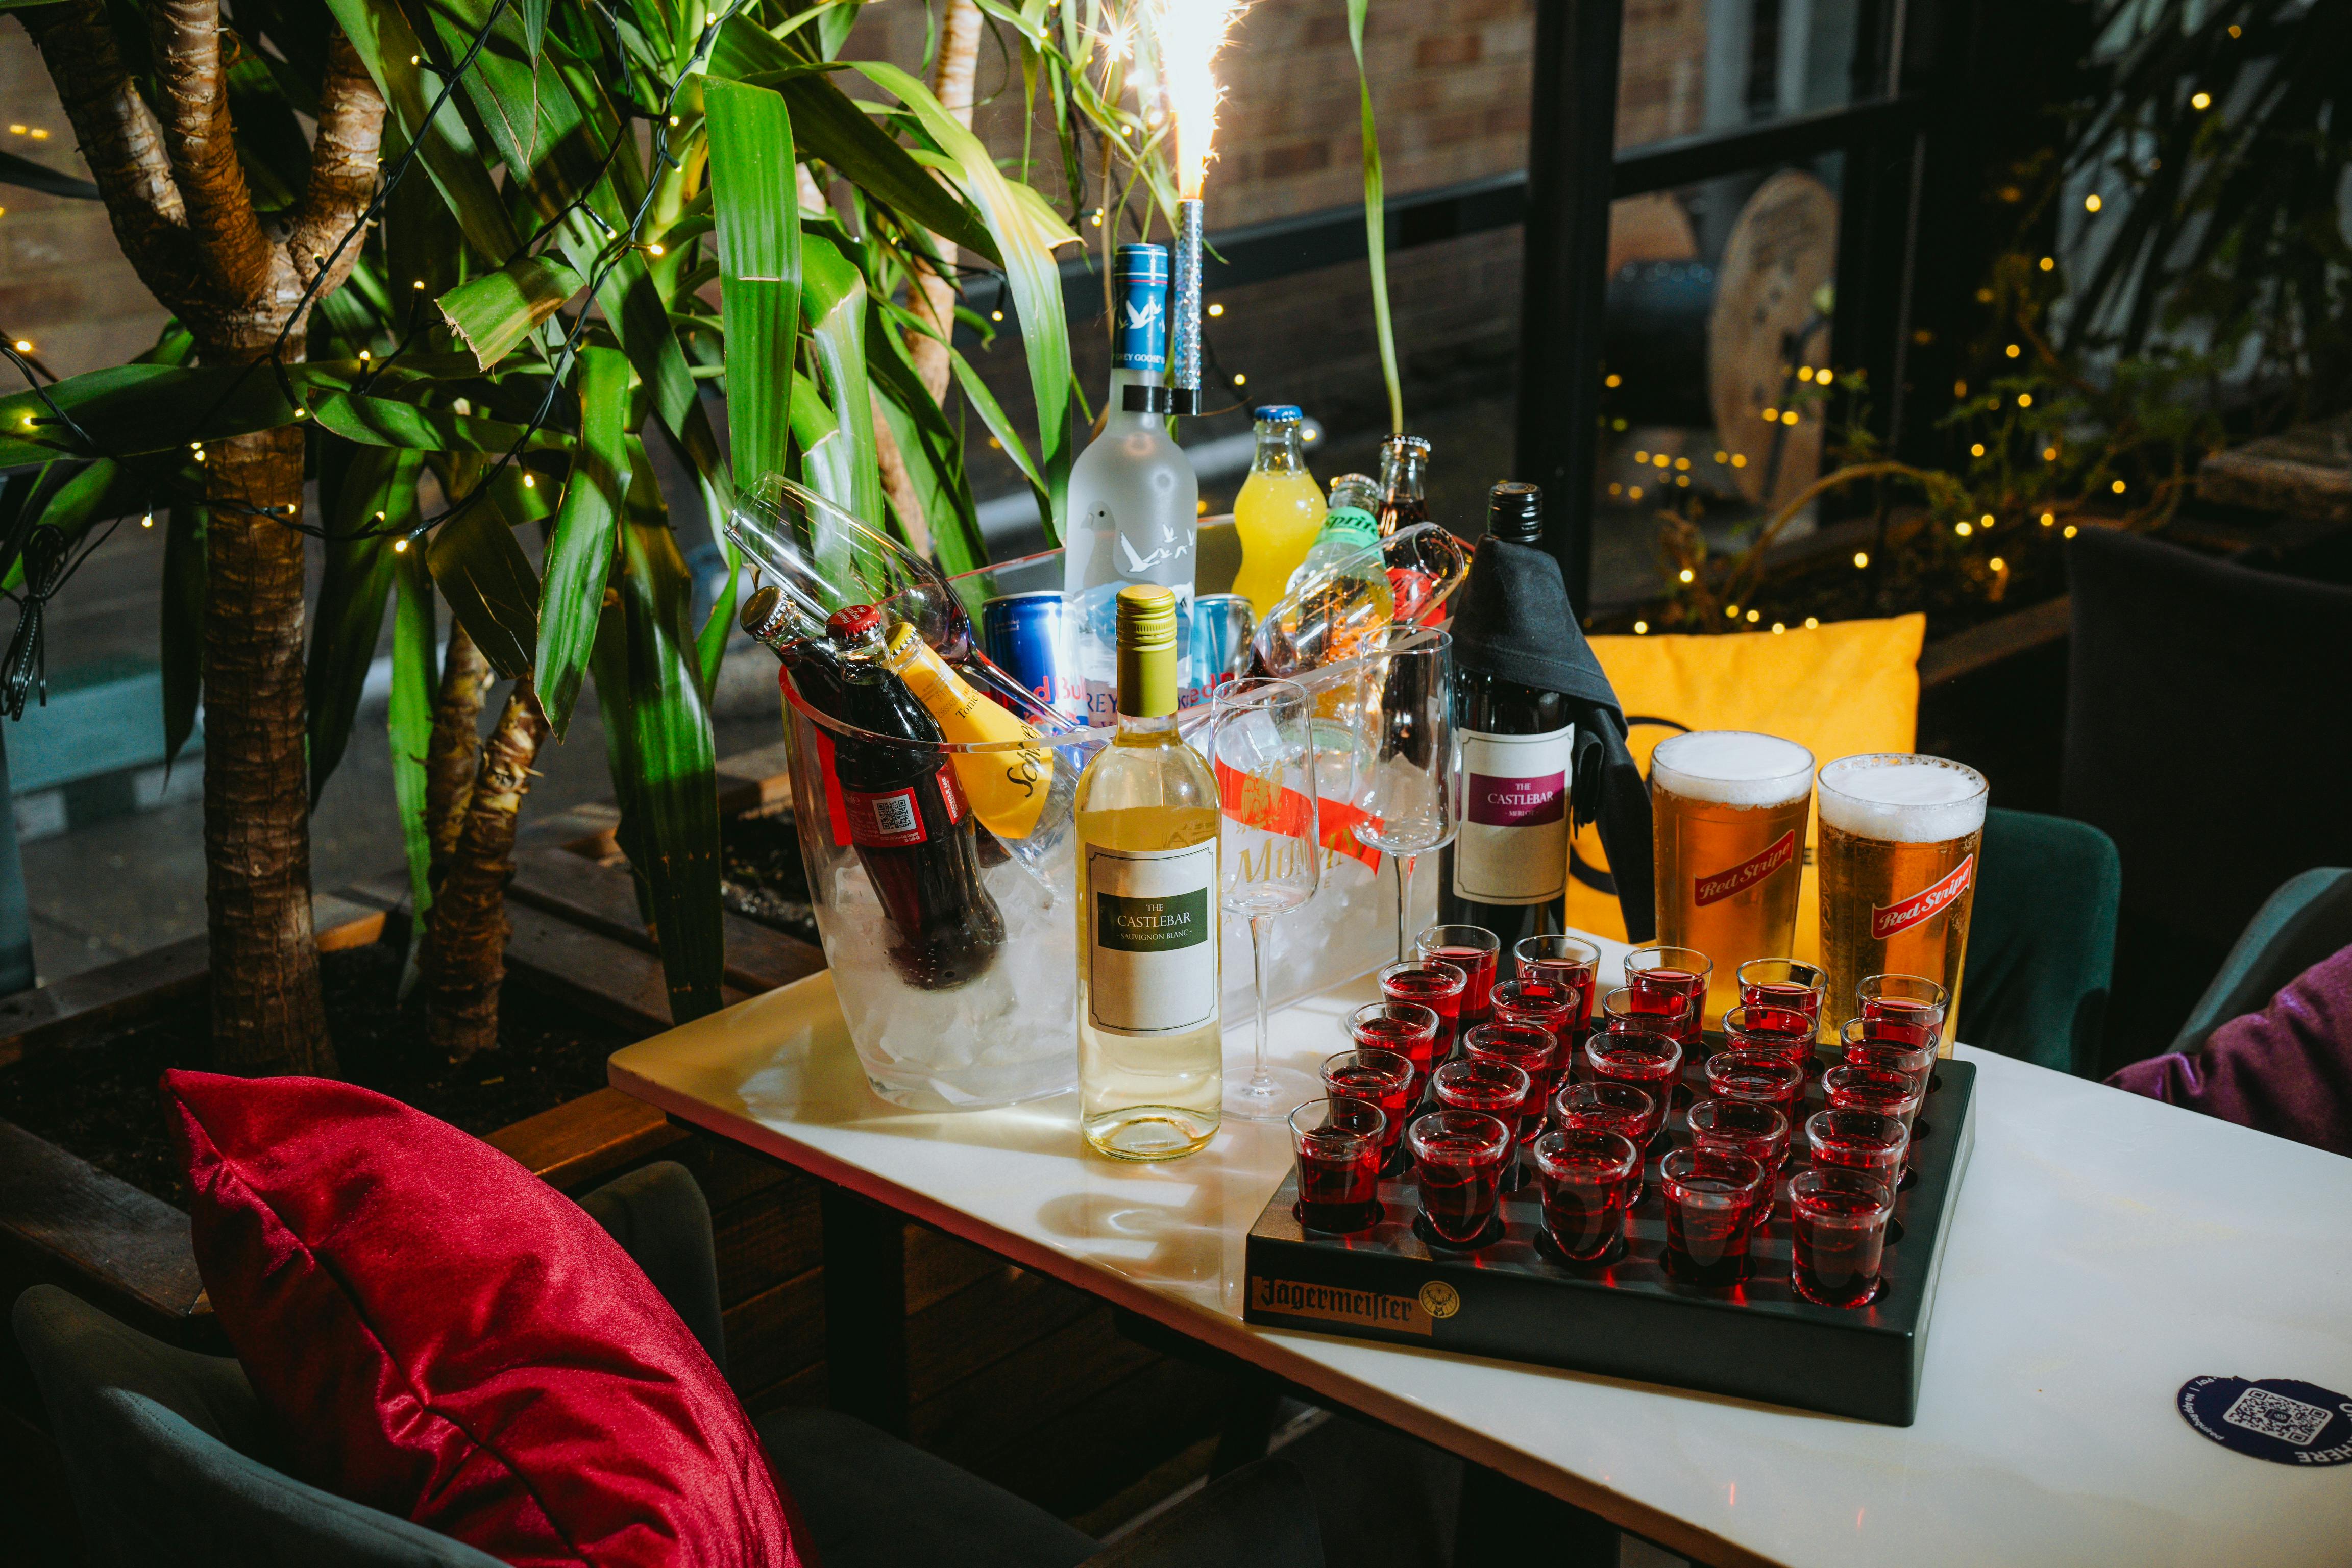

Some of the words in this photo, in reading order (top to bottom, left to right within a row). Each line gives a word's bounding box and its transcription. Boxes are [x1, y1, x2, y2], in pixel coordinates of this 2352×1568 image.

[837, 611, 852, 624] Please
[844, 607, 862, 620] recycle
[955, 695, 978, 719] Tonic
[941, 776, 948, 789] ME
[1515, 782, 1531, 791] THE
[946, 788, 958, 819] RECYCLE
[1487, 791, 1554, 805] CASTLEBAR
[1700, 873, 1739, 899] Red
[1739, 842, 1790, 883] Stripe
[1878, 902, 1921, 931] Red
[1921, 867, 1969, 912] Stripe
[1146, 903, 1164, 912] THE
[1117, 912, 1191, 928] CASTLEBAR
[1166, 929, 1188, 939] BLANC
[2196, 1377, 2214, 1386] Pay
[2185, 1393, 2195, 1402] No
[2182, 1401, 2194, 1413] App
[2294, 1443, 2352, 1463] HERE
